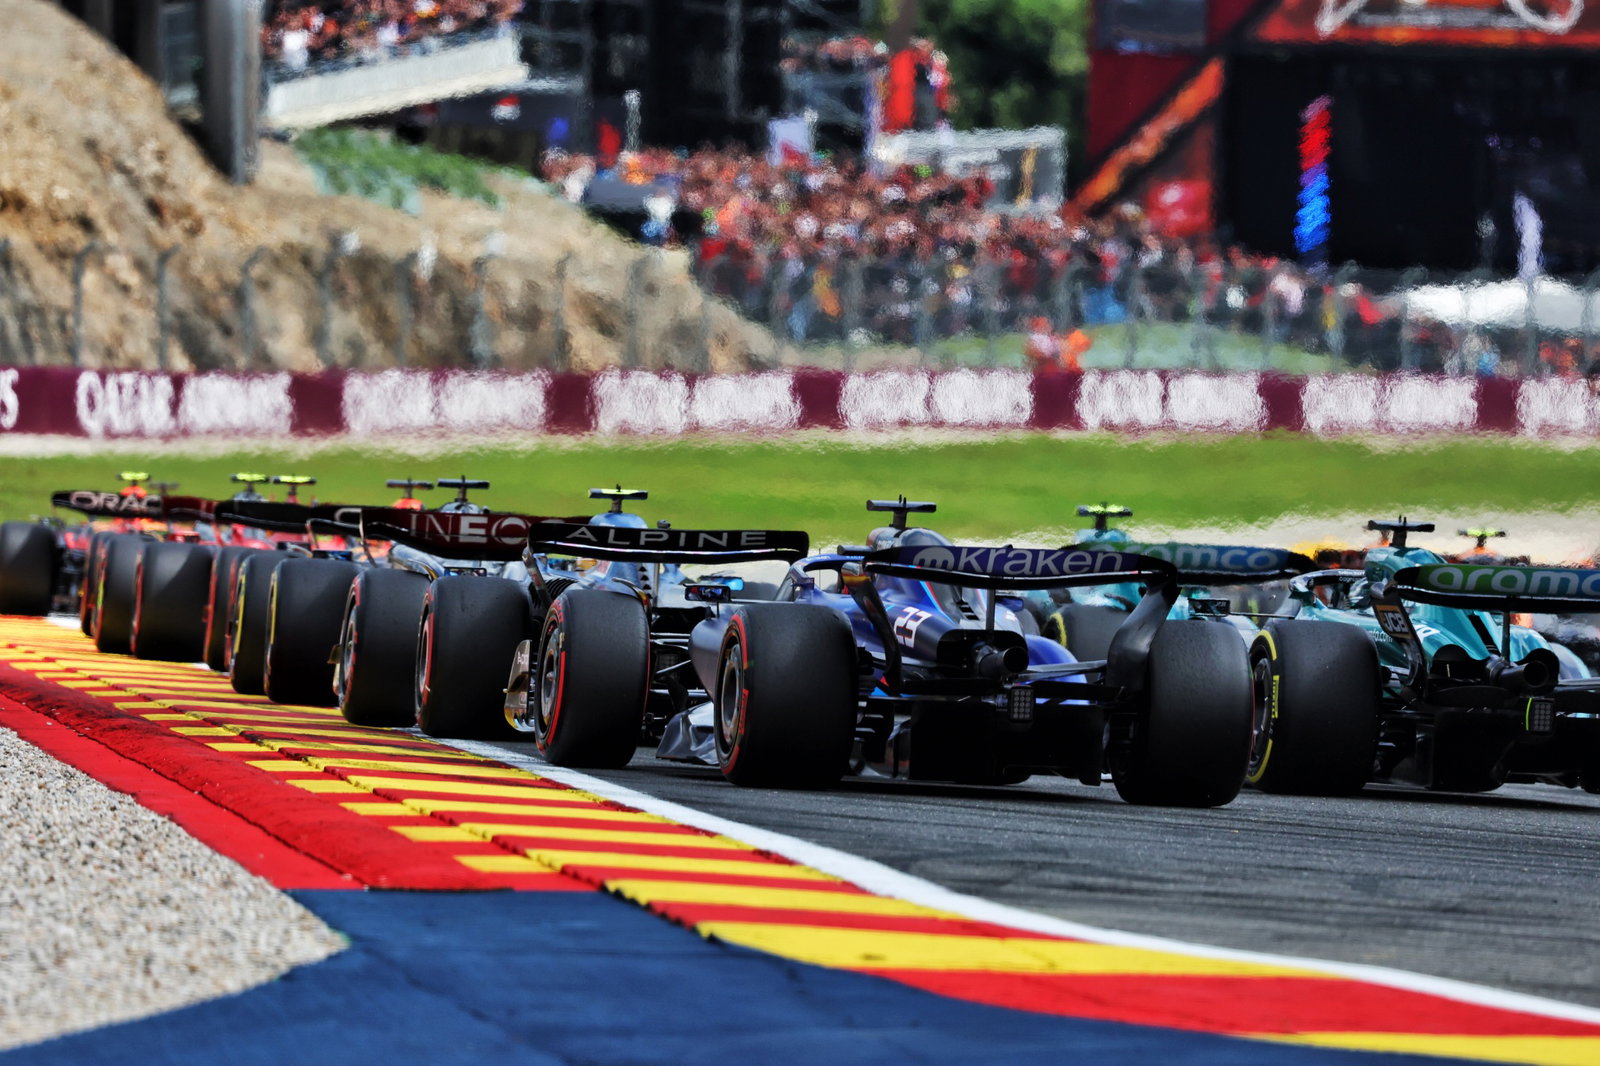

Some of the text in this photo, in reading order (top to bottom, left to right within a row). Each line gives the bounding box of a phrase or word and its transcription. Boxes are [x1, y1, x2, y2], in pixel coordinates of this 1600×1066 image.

[407, 513, 566, 545] INEO
[566, 526, 767, 548] ALPINE
[958, 548, 1123, 577] kraken
[1384, 611, 1410, 633] JCB
